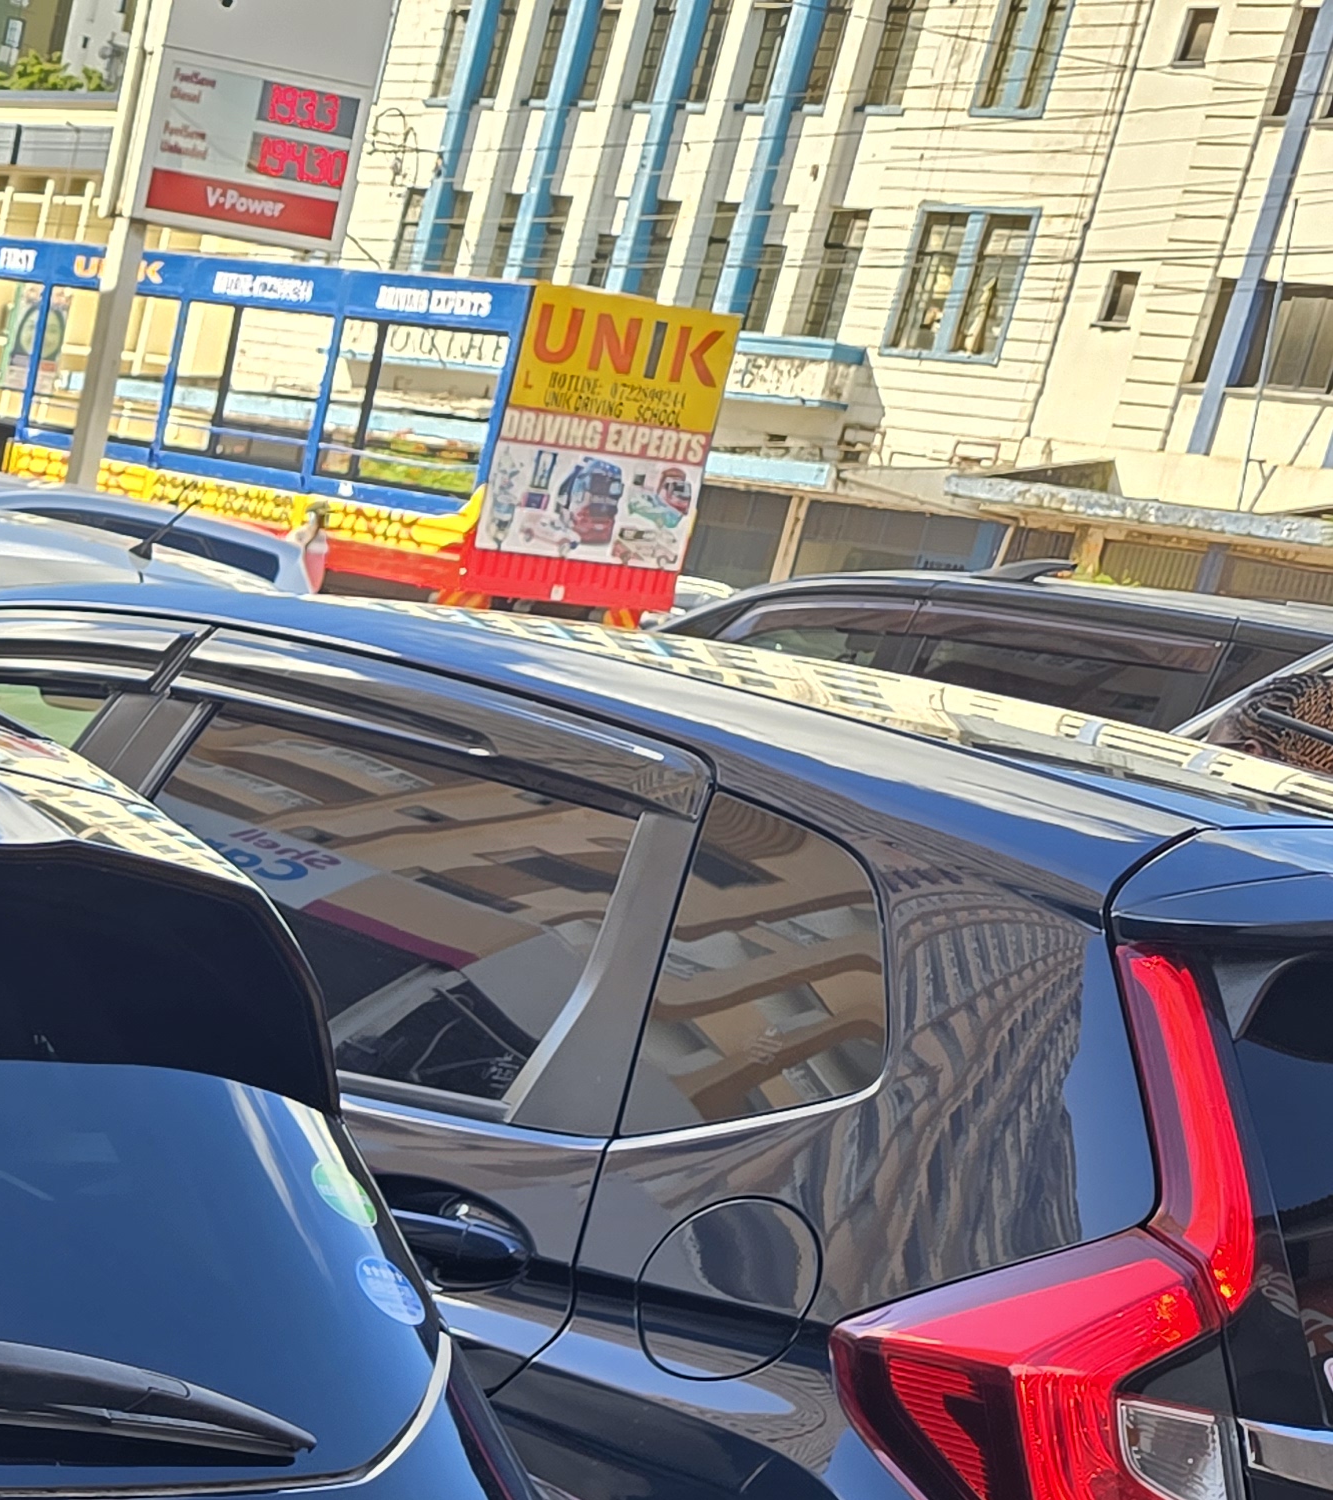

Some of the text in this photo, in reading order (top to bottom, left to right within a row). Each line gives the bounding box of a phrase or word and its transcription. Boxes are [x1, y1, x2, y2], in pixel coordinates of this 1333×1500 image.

[533, 303, 725, 388] UNIK
[523, 371, 532, 390] L
[502, 410, 706, 463] DRIVING EXPERTS
